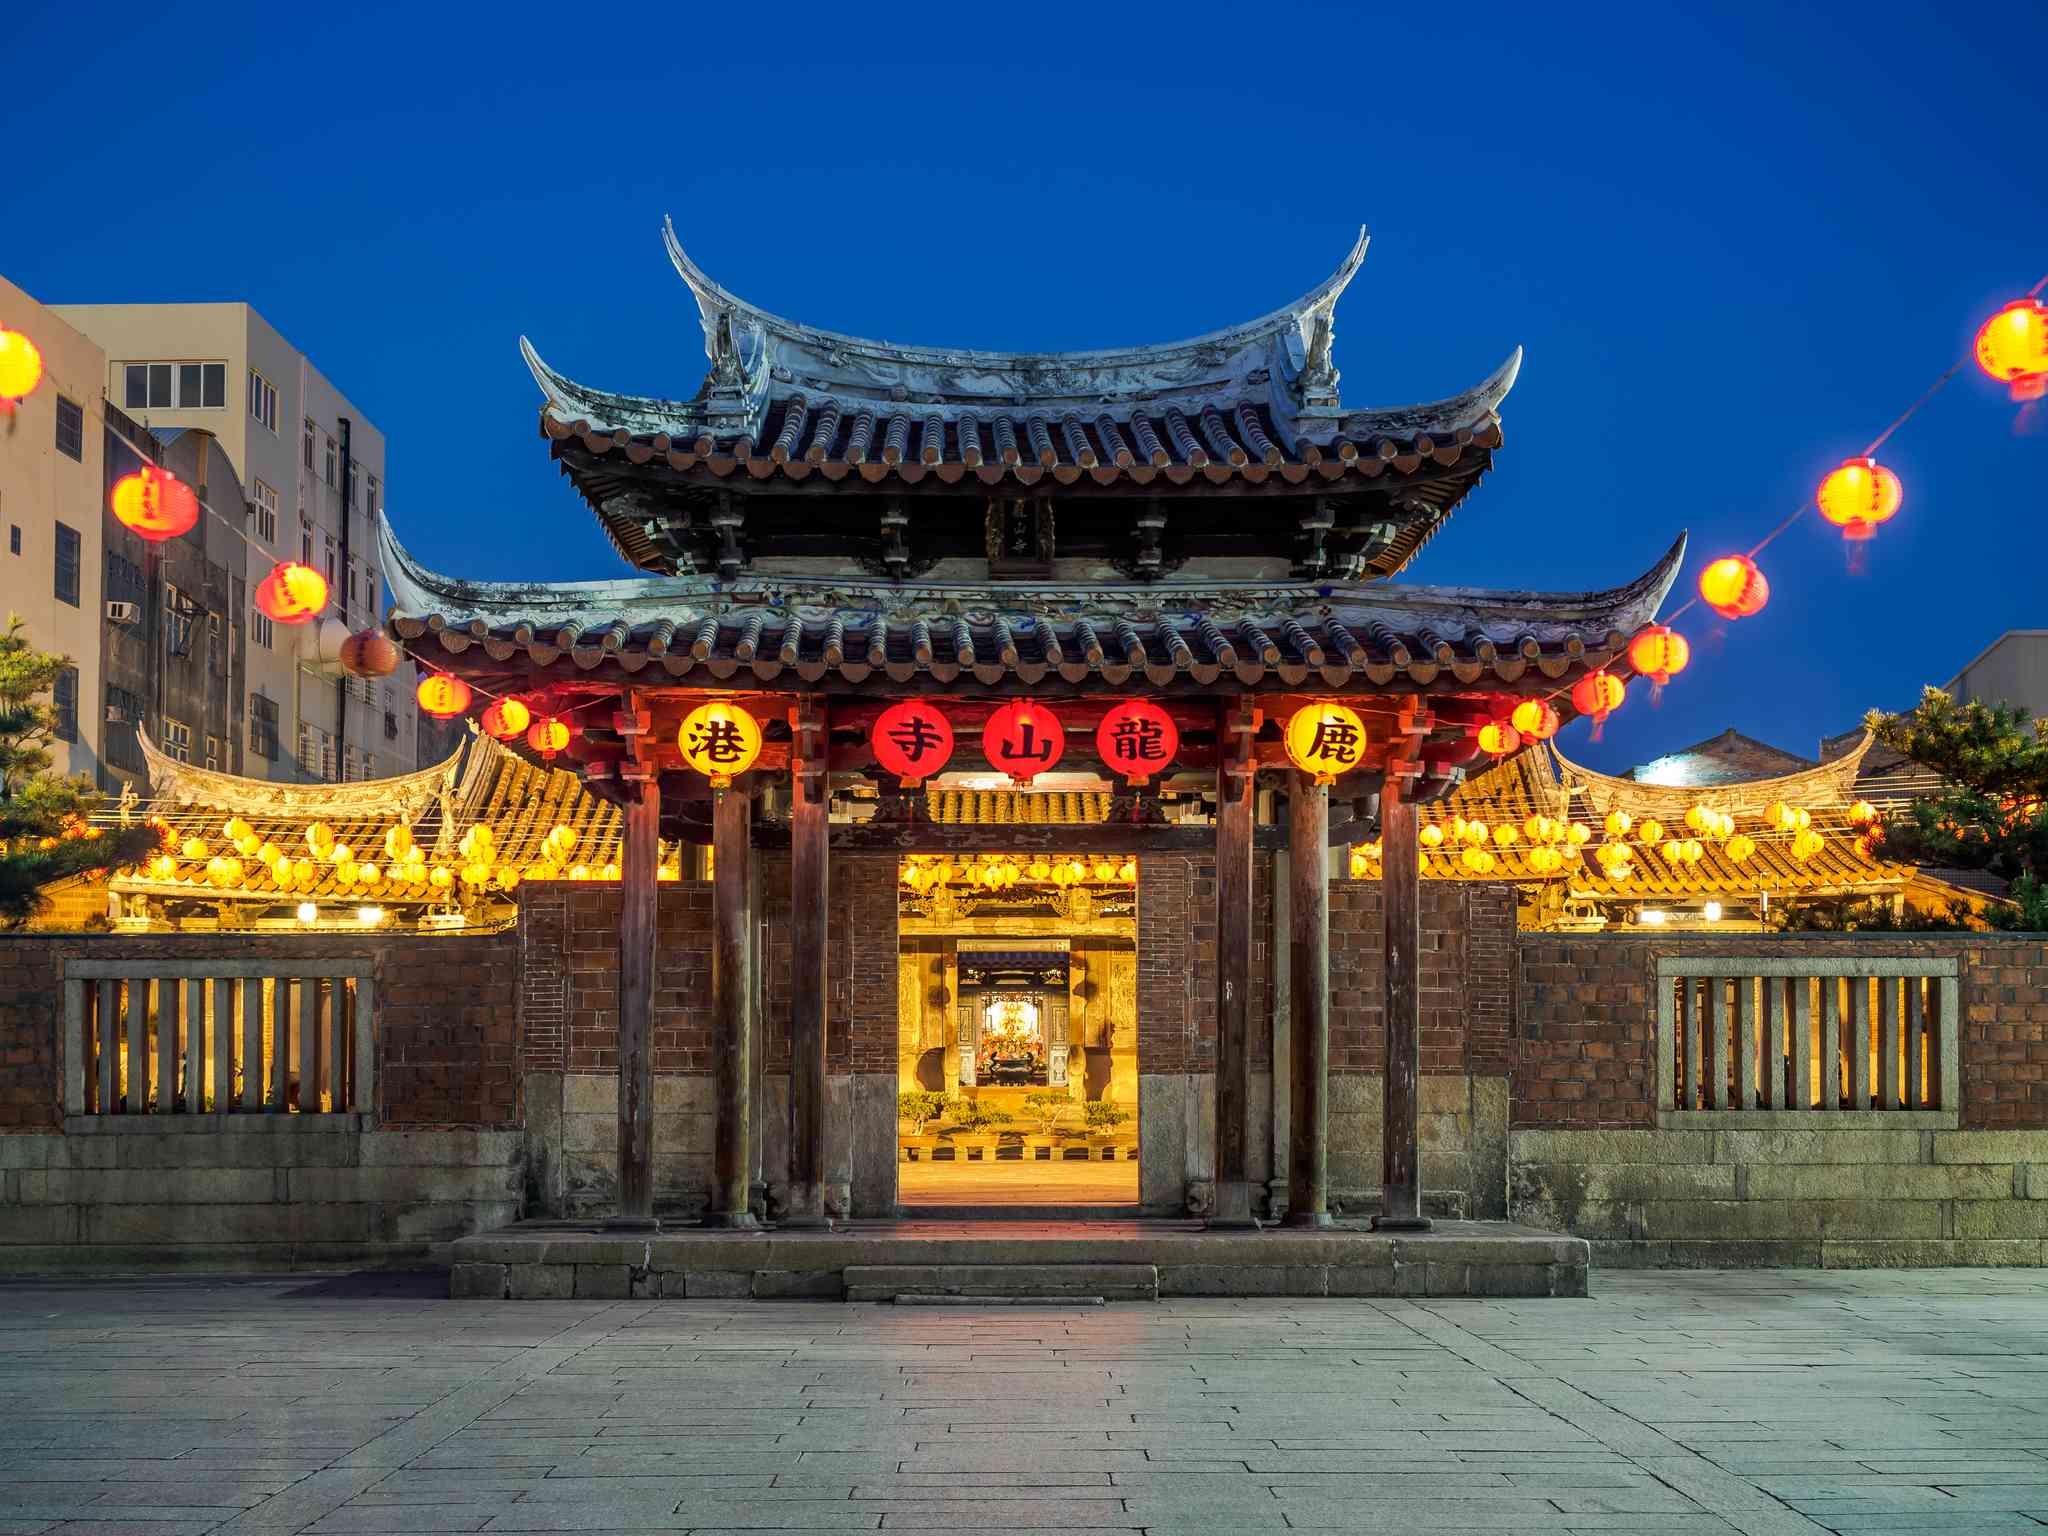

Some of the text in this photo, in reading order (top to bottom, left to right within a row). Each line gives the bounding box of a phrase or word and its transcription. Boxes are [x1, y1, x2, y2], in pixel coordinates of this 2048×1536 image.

[688, 720, 748, 763] 港
[888, 716, 944, 762] 寺
[1001, 723, 1053, 762] 山
[1110, 716, 1167, 761] 龍
[1306, 716, 1359, 764] 鹿
